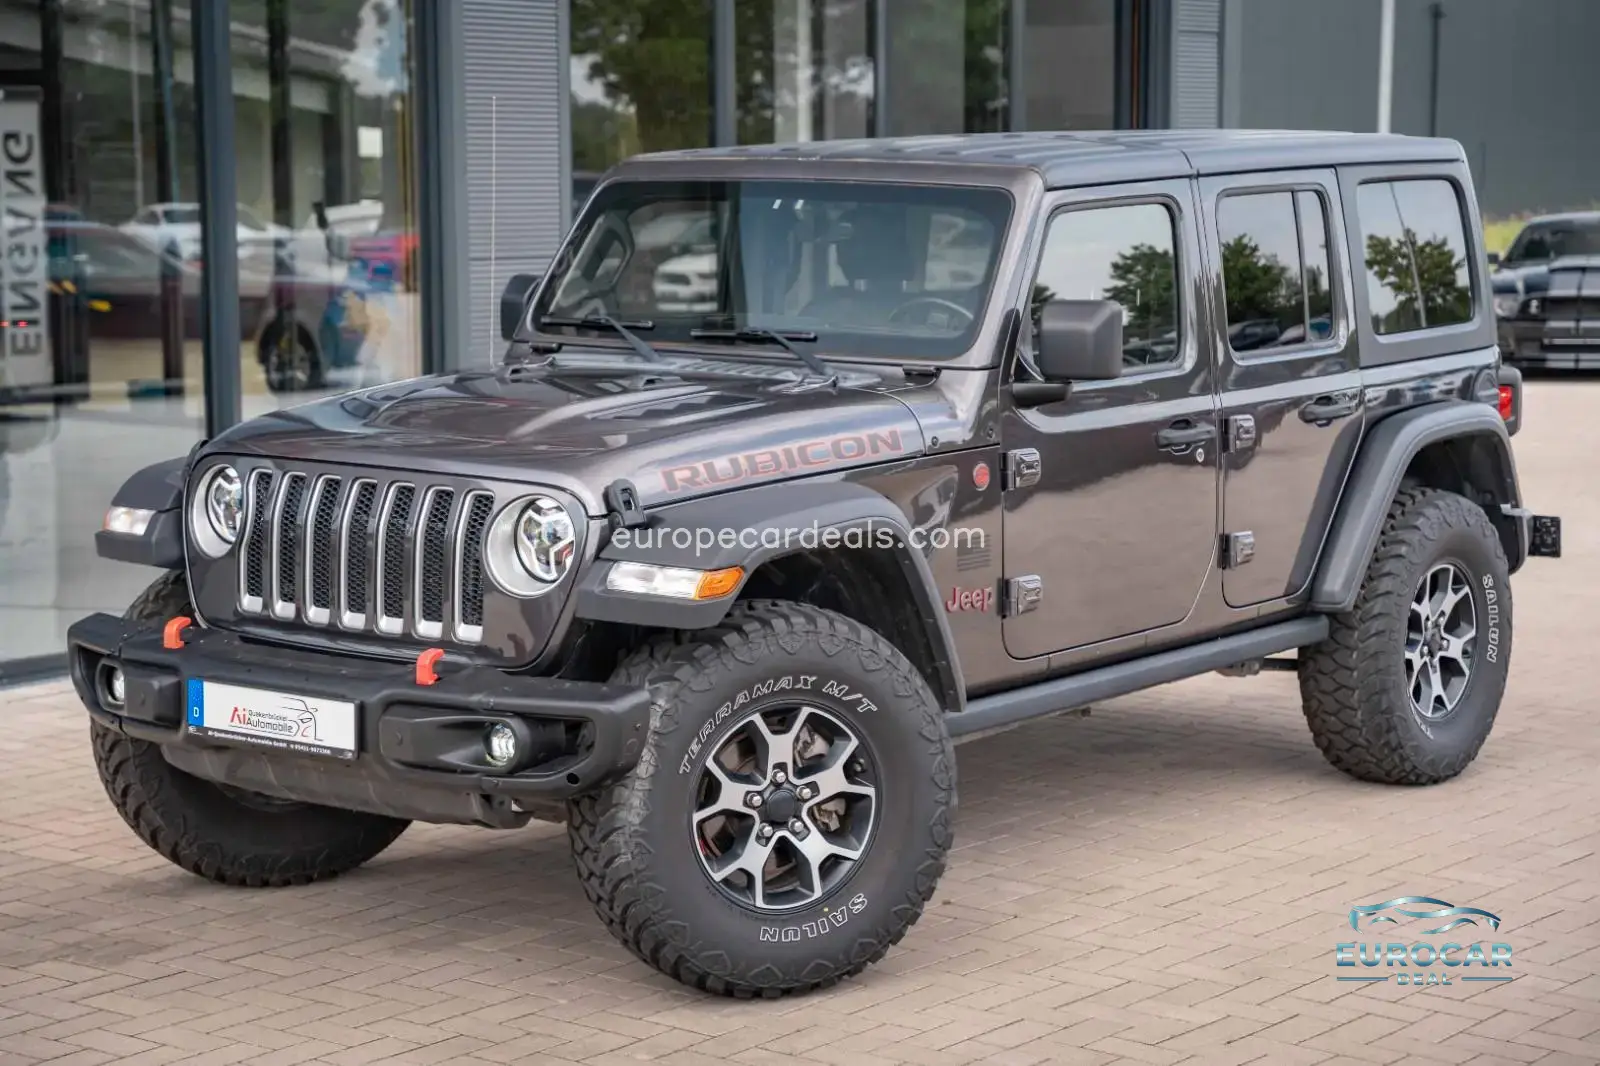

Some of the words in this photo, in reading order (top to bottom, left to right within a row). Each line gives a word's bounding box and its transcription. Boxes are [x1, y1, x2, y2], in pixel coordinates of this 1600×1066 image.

[660, 427, 904, 494] RUBICON
[945, 585, 993, 613] Jeep
[1482, 573, 1500, 663] SAILUN
[193, 706, 200, 718] D
[246, 717, 294, 734] Automobile
[679, 675, 817, 776] TERRAMAX
[822, 679, 878, 714] M/T
[759, 892, 868, 942] SAILUN
